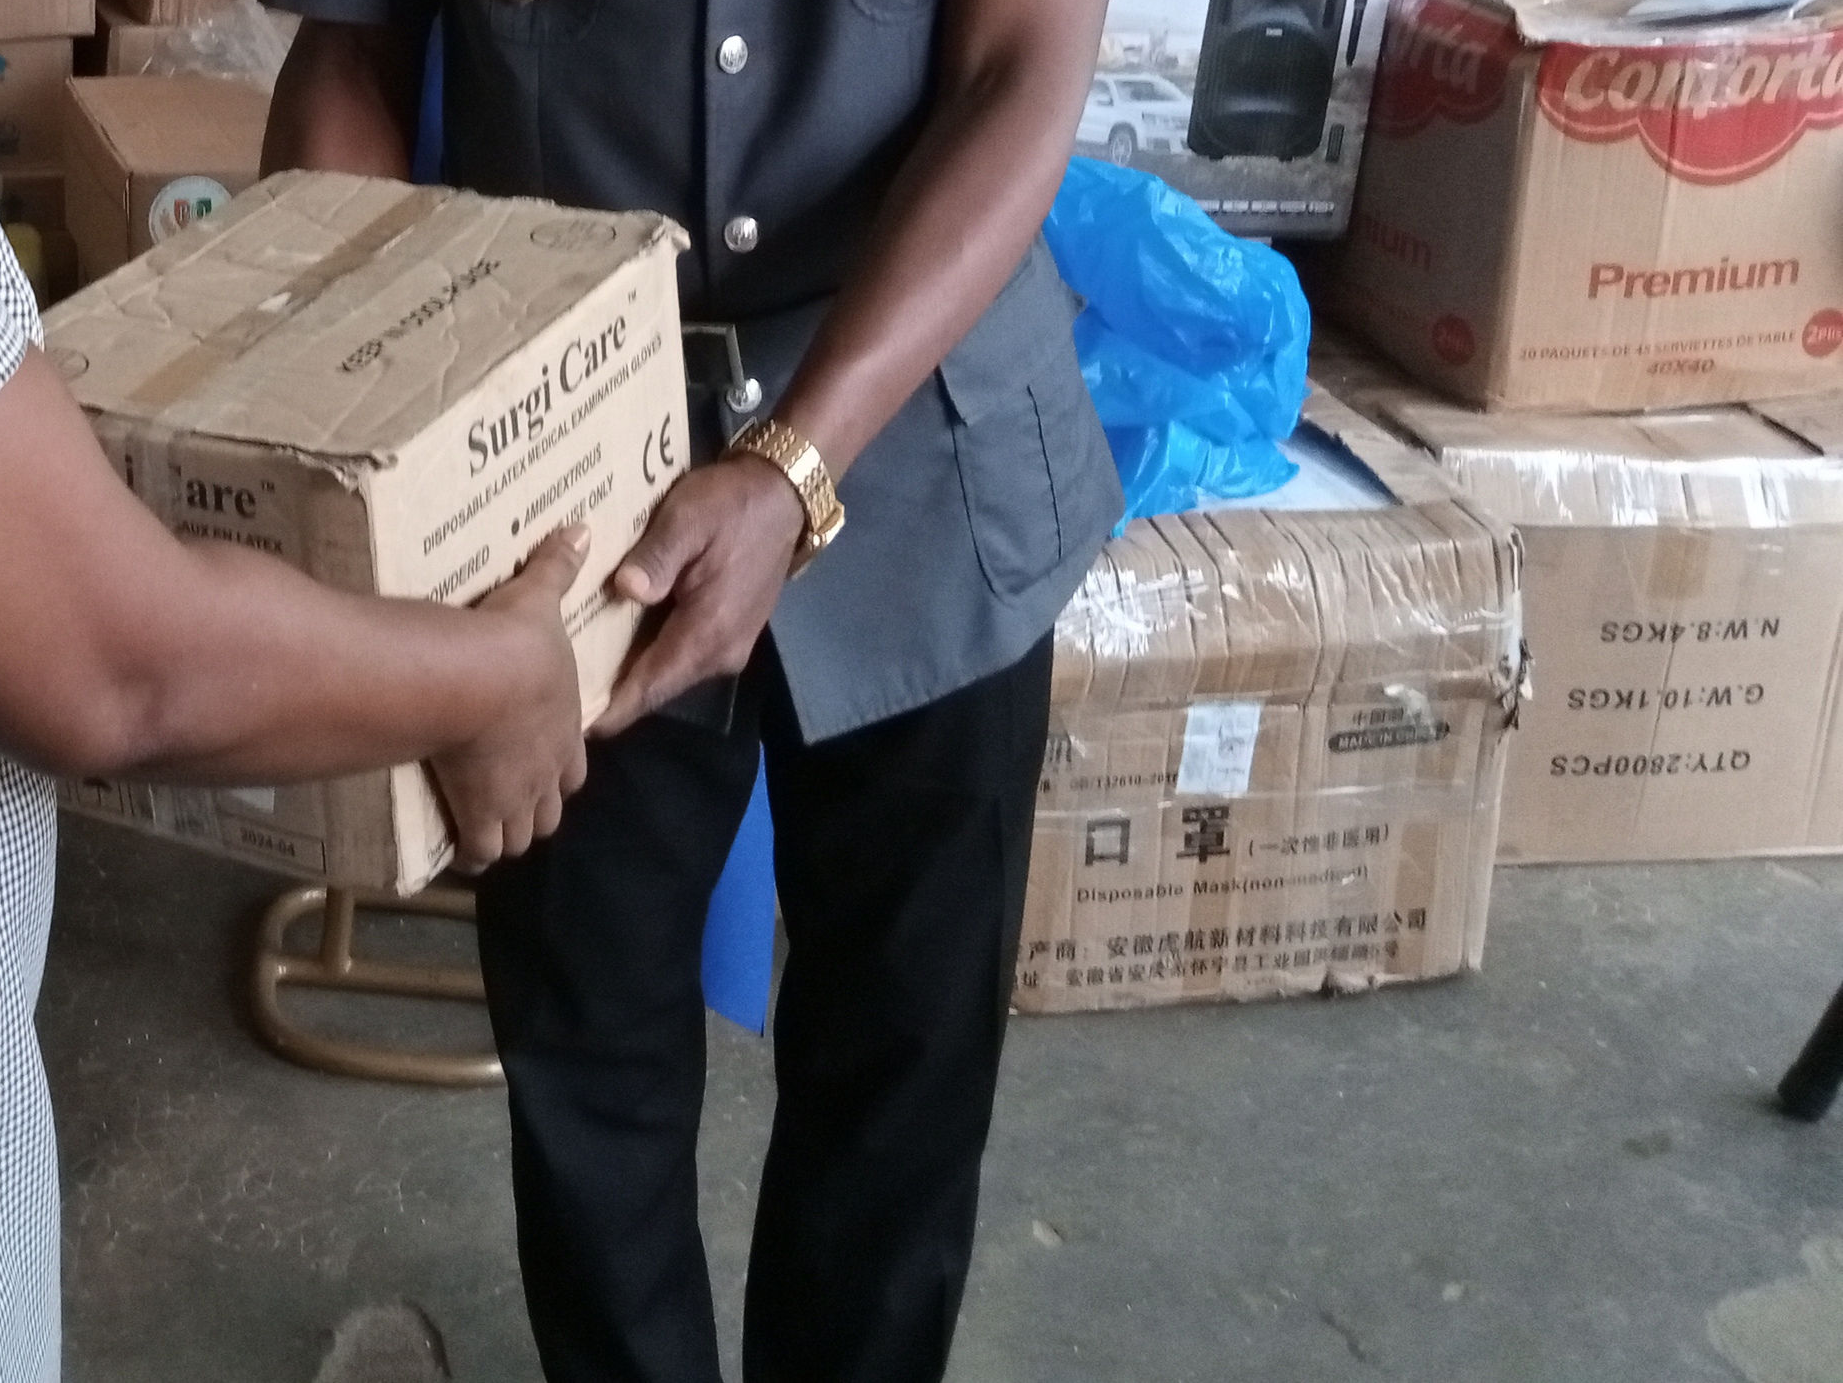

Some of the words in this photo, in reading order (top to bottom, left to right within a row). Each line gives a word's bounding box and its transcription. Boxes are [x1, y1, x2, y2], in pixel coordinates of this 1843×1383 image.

[1587, 255, 1800, 301] Premium
[467, 364, 552, 478] Surgi
[559, 315, 627, 395] Care
[528, 419, 571, 474] MEDICAL
[571, 365, 631, 431] EXAMINATION
[631, 331, 663, 376] GLOVES
[523, 442, 603, 529] AMBIDEXTROUS
[588, 473, 614, 509] ONLY
[425, 544, 491, 605] OWDERED
[1077, 881, 1185, 906] Disposable
